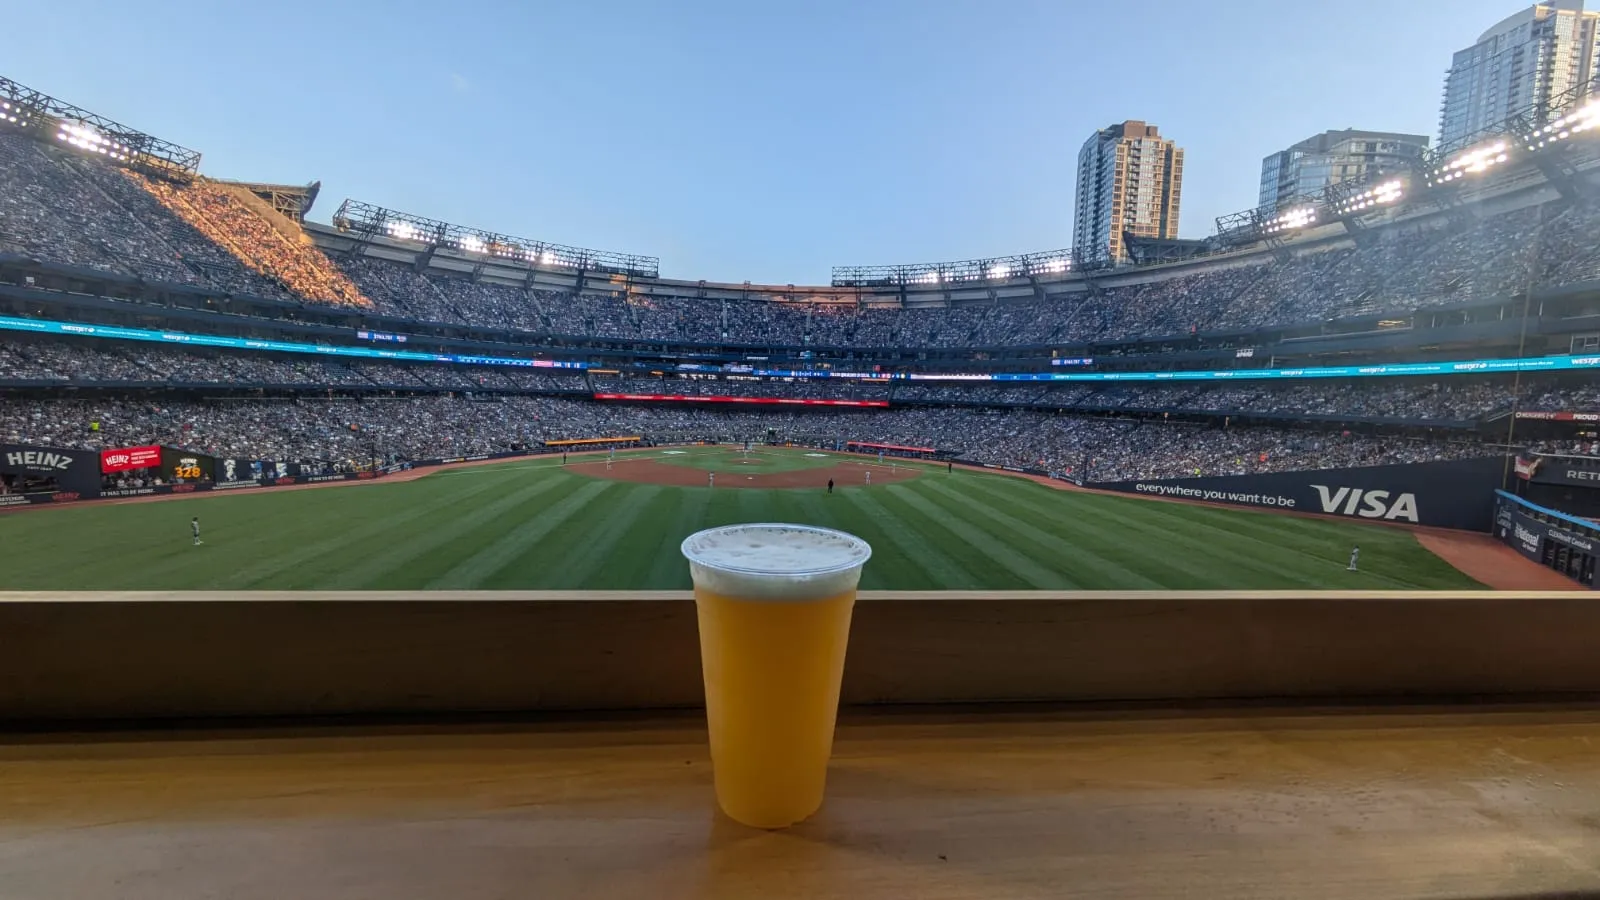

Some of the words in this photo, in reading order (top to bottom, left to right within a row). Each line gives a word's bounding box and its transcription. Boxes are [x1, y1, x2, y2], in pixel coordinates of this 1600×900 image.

[7, 451, 73, 469] HEINZ
[105, 455, 129, 466] HEINZ
[175, 466, 201, 478] 328
[1135, 483, 1202, 497] everywhere
[1203, 490, 1226, 500] you
[1228, 492, 1260, 503] want
[1262, 495, 1276, 505] to
[1278, 496, 1296, 507] be
[1309, 484, 1419, 522] VISA
